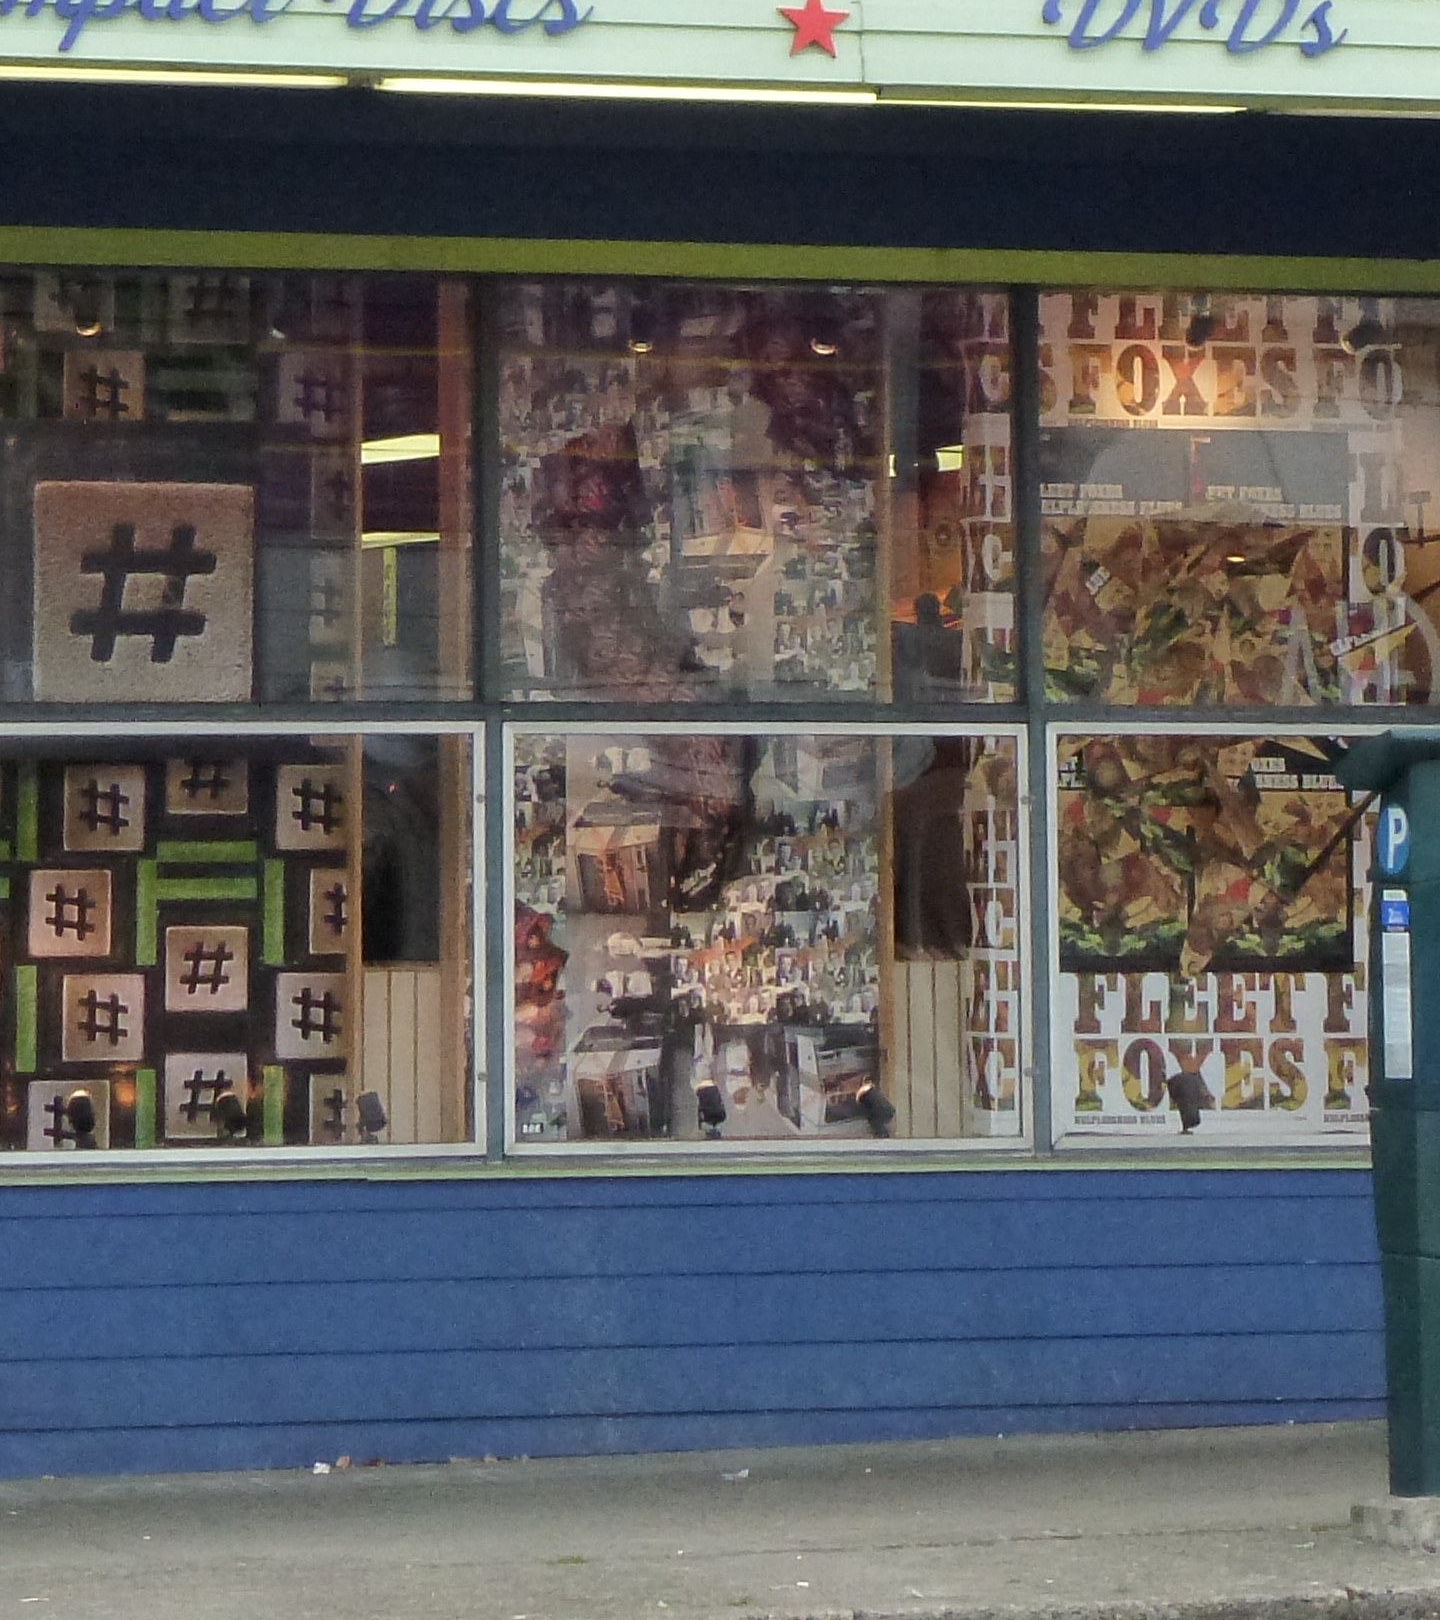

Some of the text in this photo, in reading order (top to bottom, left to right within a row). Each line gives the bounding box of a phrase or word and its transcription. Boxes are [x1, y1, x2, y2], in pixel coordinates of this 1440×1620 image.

[1068, 343, 1297, 417] FOXES
[1386, 806, 1408, 869] P
[1072, 968, 1307, 1035] FLEET
